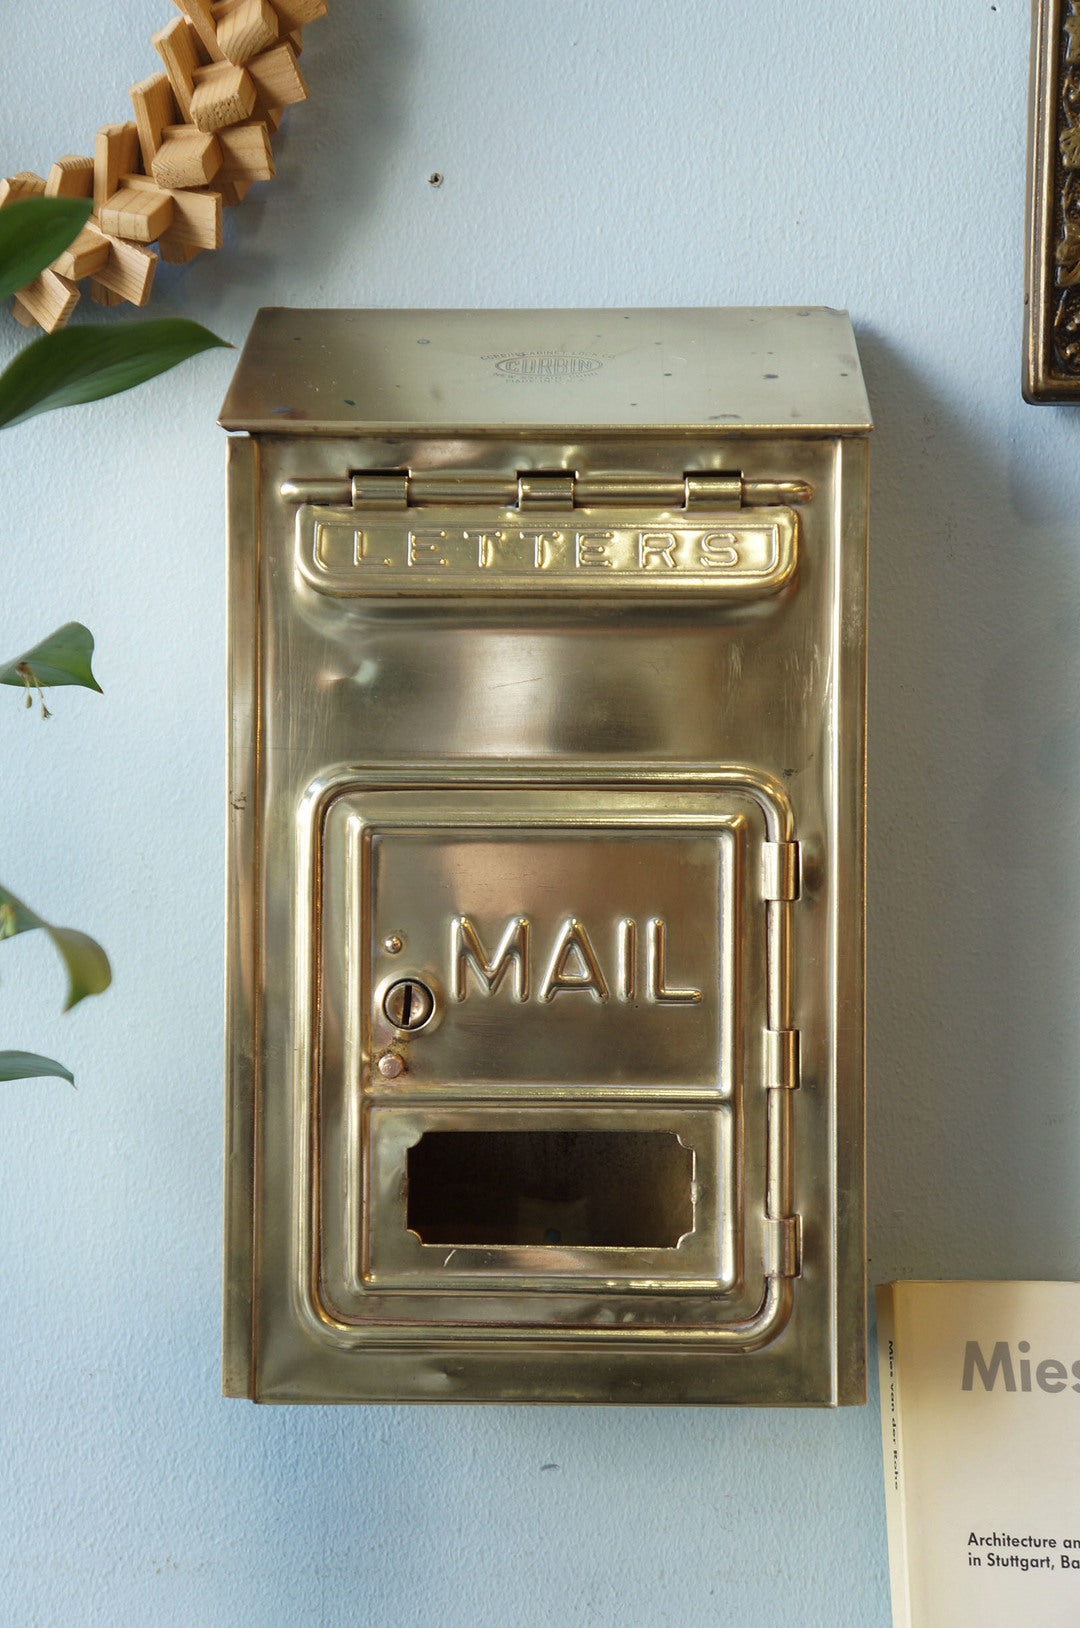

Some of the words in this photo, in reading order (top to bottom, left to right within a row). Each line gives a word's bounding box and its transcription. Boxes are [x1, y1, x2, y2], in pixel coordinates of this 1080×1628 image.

[505, 358, 592, 375] CORBIN
[353, 530, 739, 568] LETTERS
[449, 916, 703, 1005] MAIL
[968, 1532, 1057, 1549] Architecture
[968, 1552, 982, 1567] in
[987, 1553, 1055, 1572] Stuttgart,
[1061, 1555, 1080, 1569] Ba
